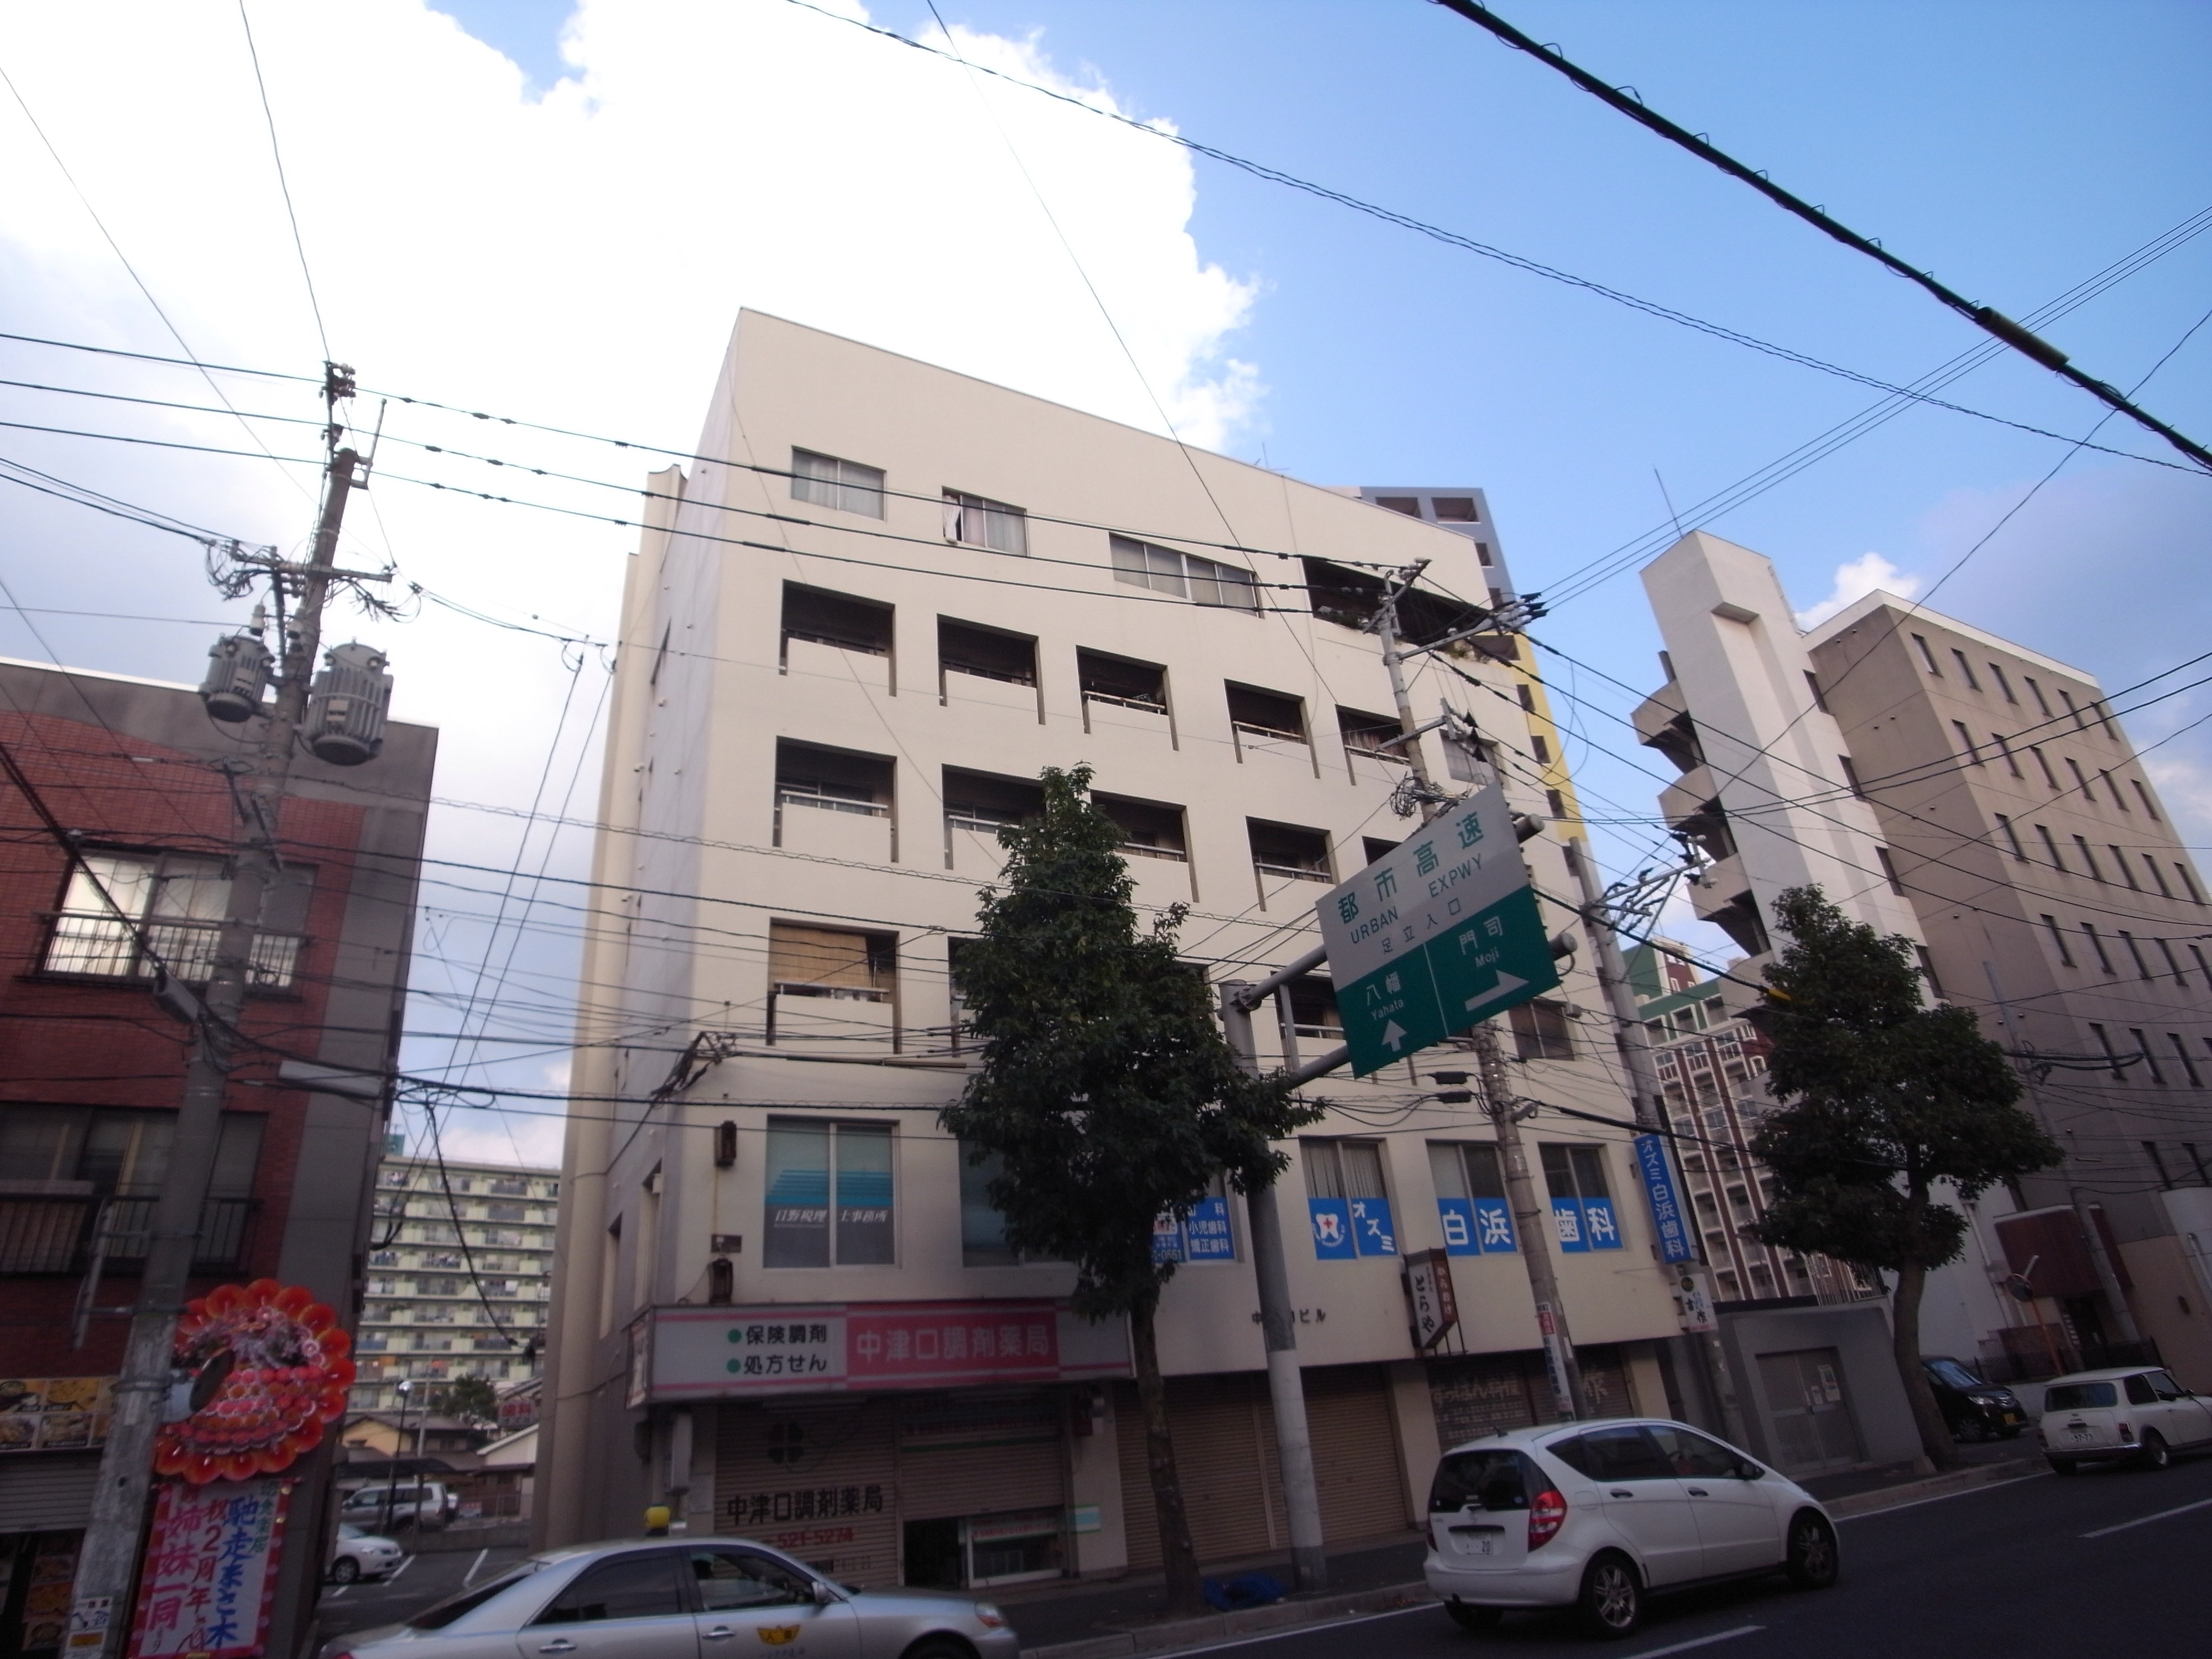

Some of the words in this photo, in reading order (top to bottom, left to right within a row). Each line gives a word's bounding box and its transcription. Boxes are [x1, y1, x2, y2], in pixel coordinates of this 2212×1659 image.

[1338, 811, 1484, 925] 都市高速
[1350, 906, 1399, 944] URBAN
[1428, 853, 1483, 898] EXPWY
[1381, 898, 1462, 954] 足立入口
[1459, 916, 1503, 956] 門司
[1475, 948, 1500, 968] Moji
[1366, 971, 1401, 1006] 八幡
[1370, 998, 1405, 1021] Yahata
[1442, 1209, 1511, 1244] 白浜
[1555, 1208, 1614, 1241] 歯科
[747, 1324, 828, 1345] 保険調剤
[857, 1324, 1048, 1363] 中津口調剤薬局
[744, 1353, 827, 1374] 処方せん
[727, 1485, 883, 1527] 中津口調剤薬局
